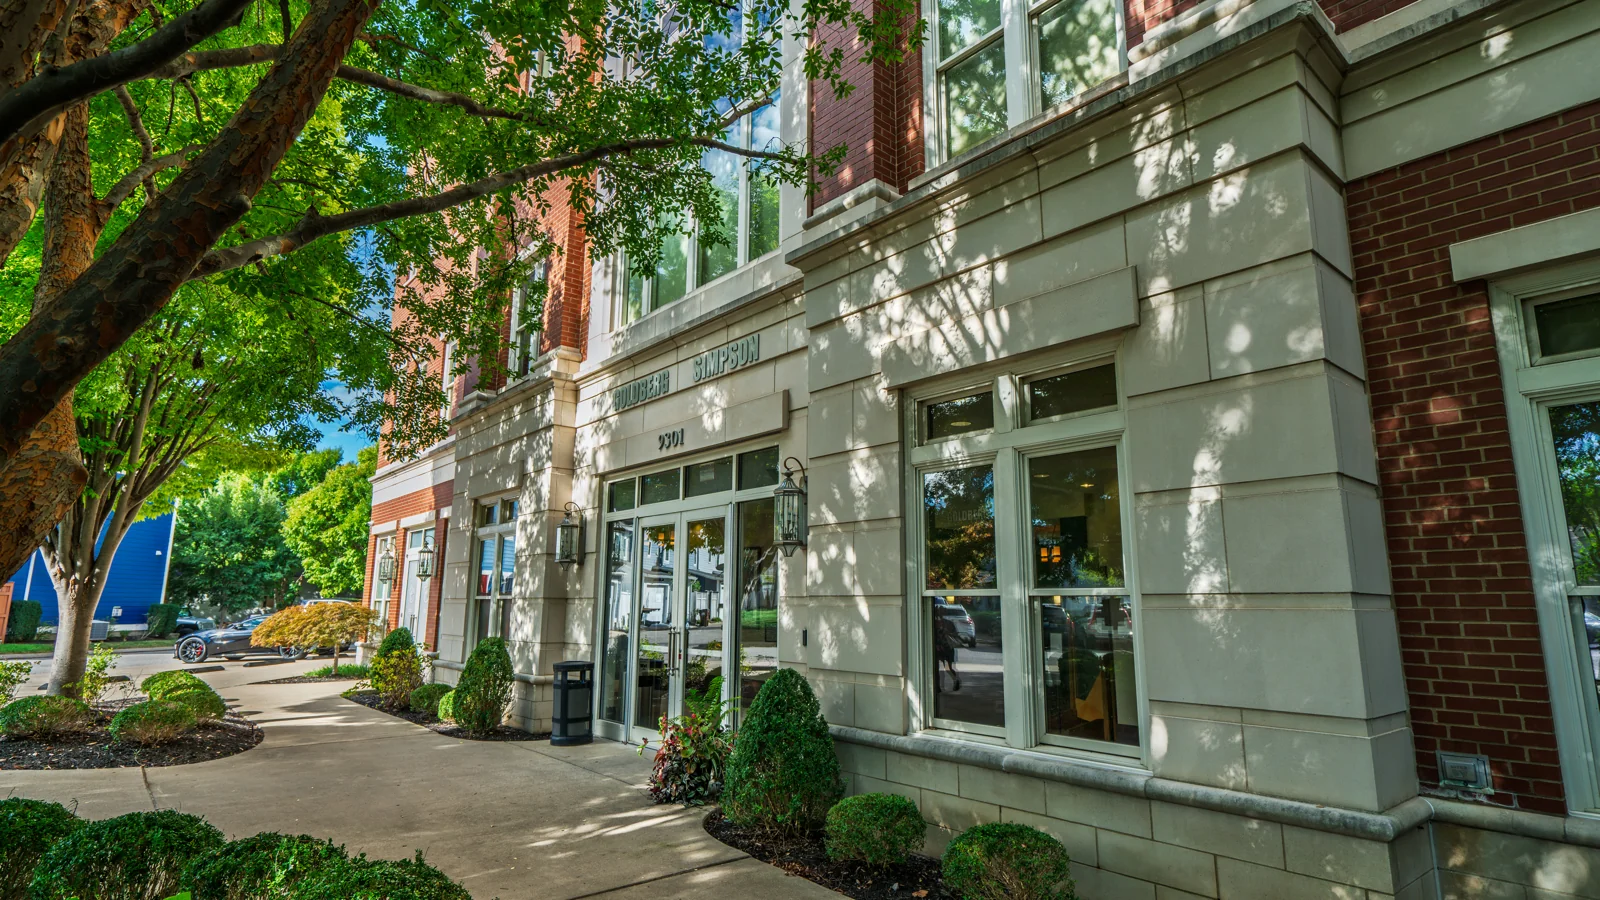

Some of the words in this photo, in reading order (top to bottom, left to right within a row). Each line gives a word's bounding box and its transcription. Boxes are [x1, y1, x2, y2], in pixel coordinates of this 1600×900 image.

[613, 370, 670, 411] GOLDBERG
[693, 333, 760, 382] SIMPSON
[658, 428, 685, 450] 9301
